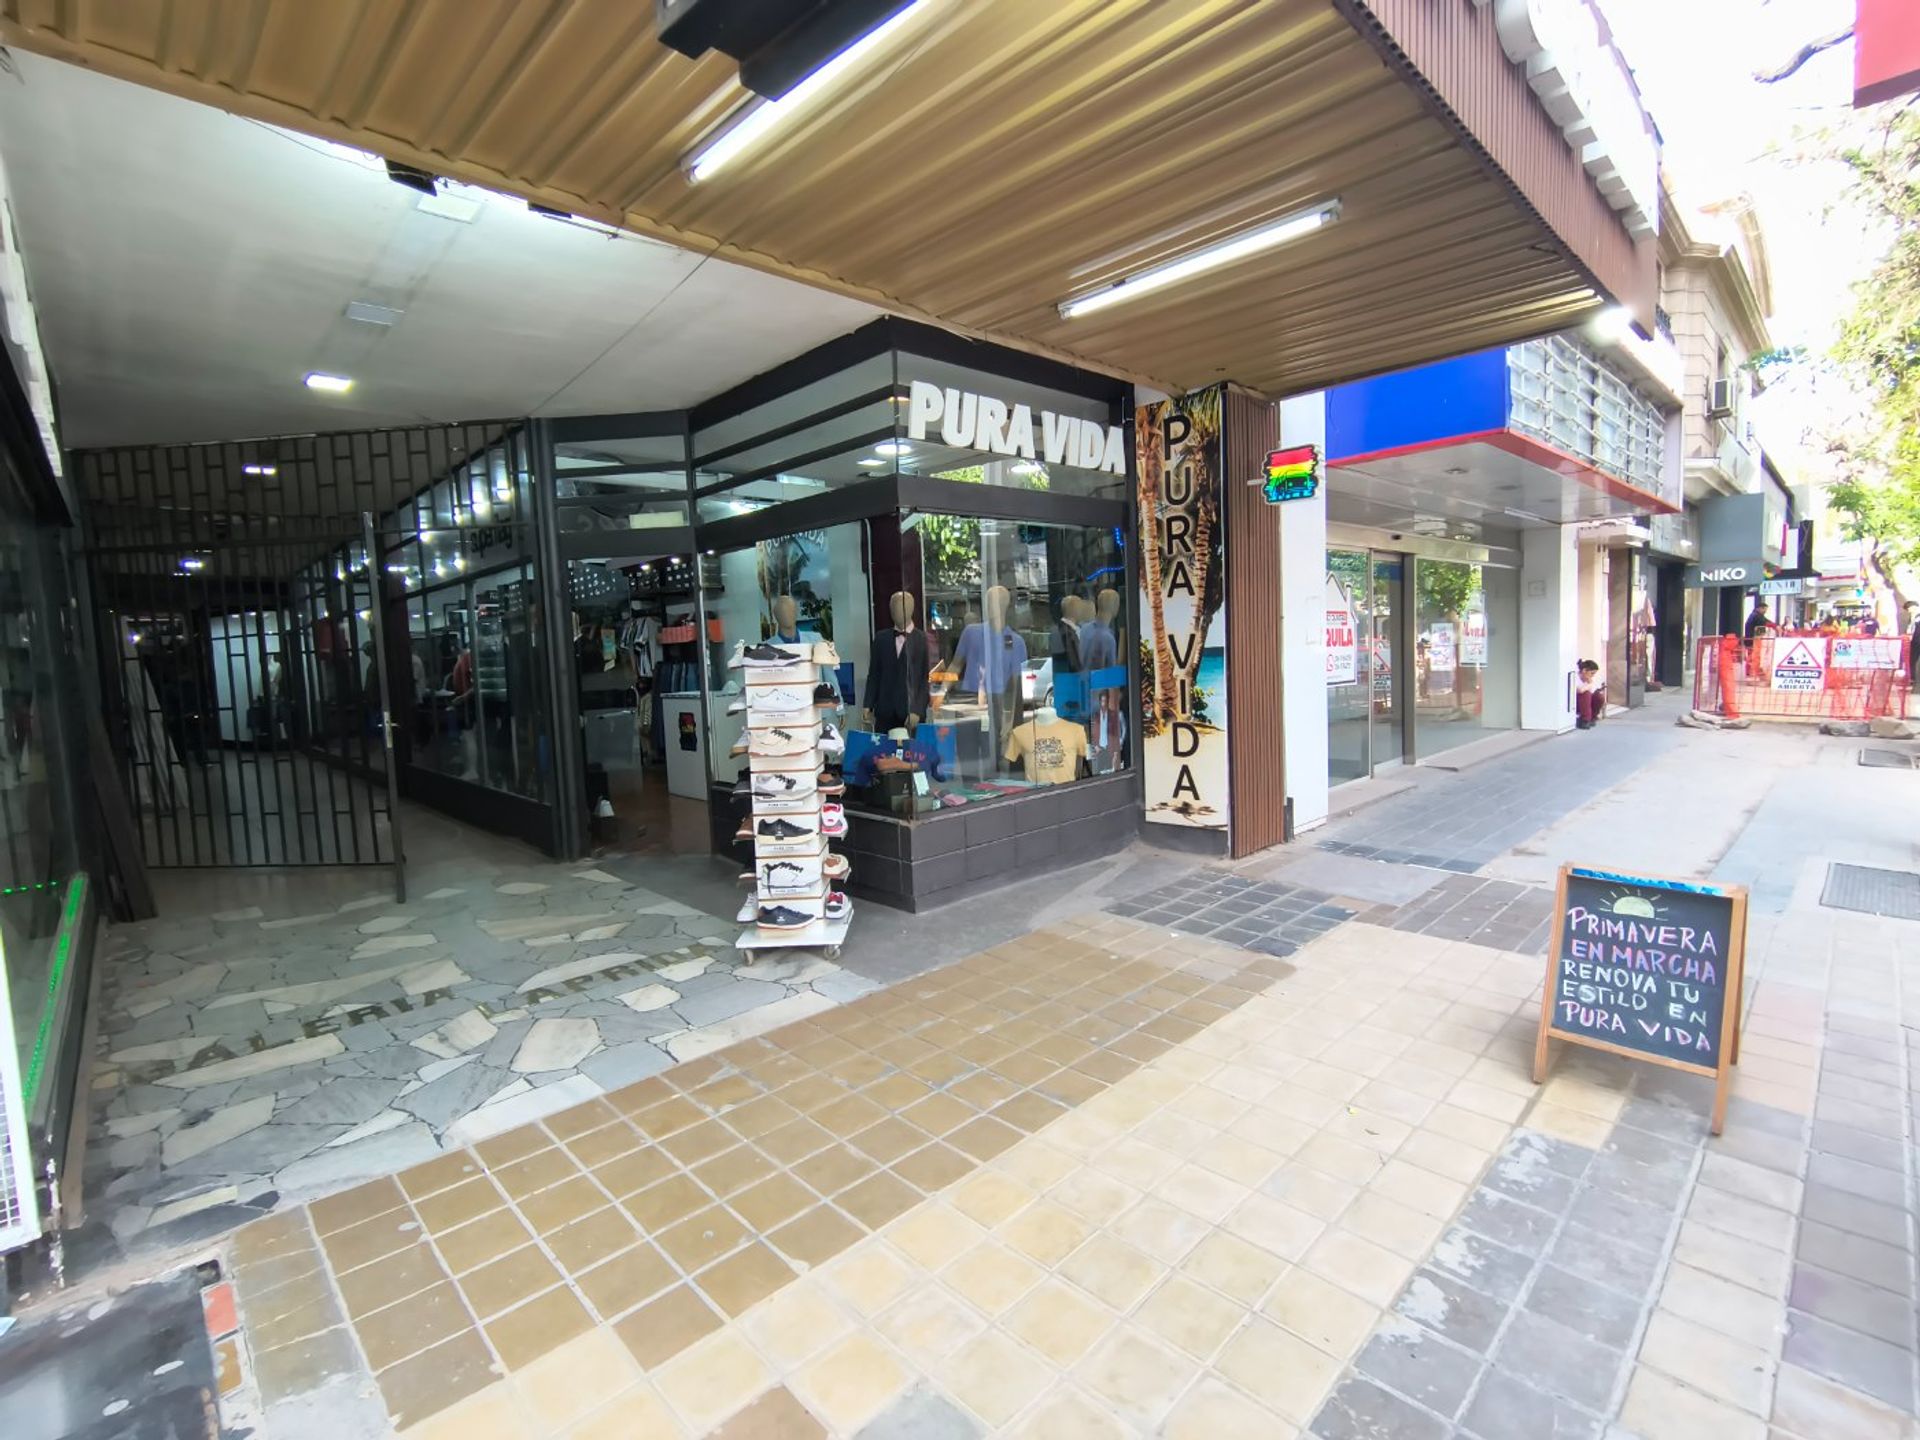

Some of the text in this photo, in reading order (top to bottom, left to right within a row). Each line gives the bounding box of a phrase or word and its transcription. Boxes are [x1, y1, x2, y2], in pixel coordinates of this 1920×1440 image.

[908, 380, 1126, 475] PURA VIDA
[1701, 567, 1747, 582] NIKO
[1163, 415, 1200, 800] PURA VIDA
[1561, 959, 1699, 1004] RENOVA TU
[1571, 939, 1716, 986] EN MARCHA
[1559, 1000, 1711, 1051] PURA VIDA
[1668, 1002, 1707, 1028] EN
